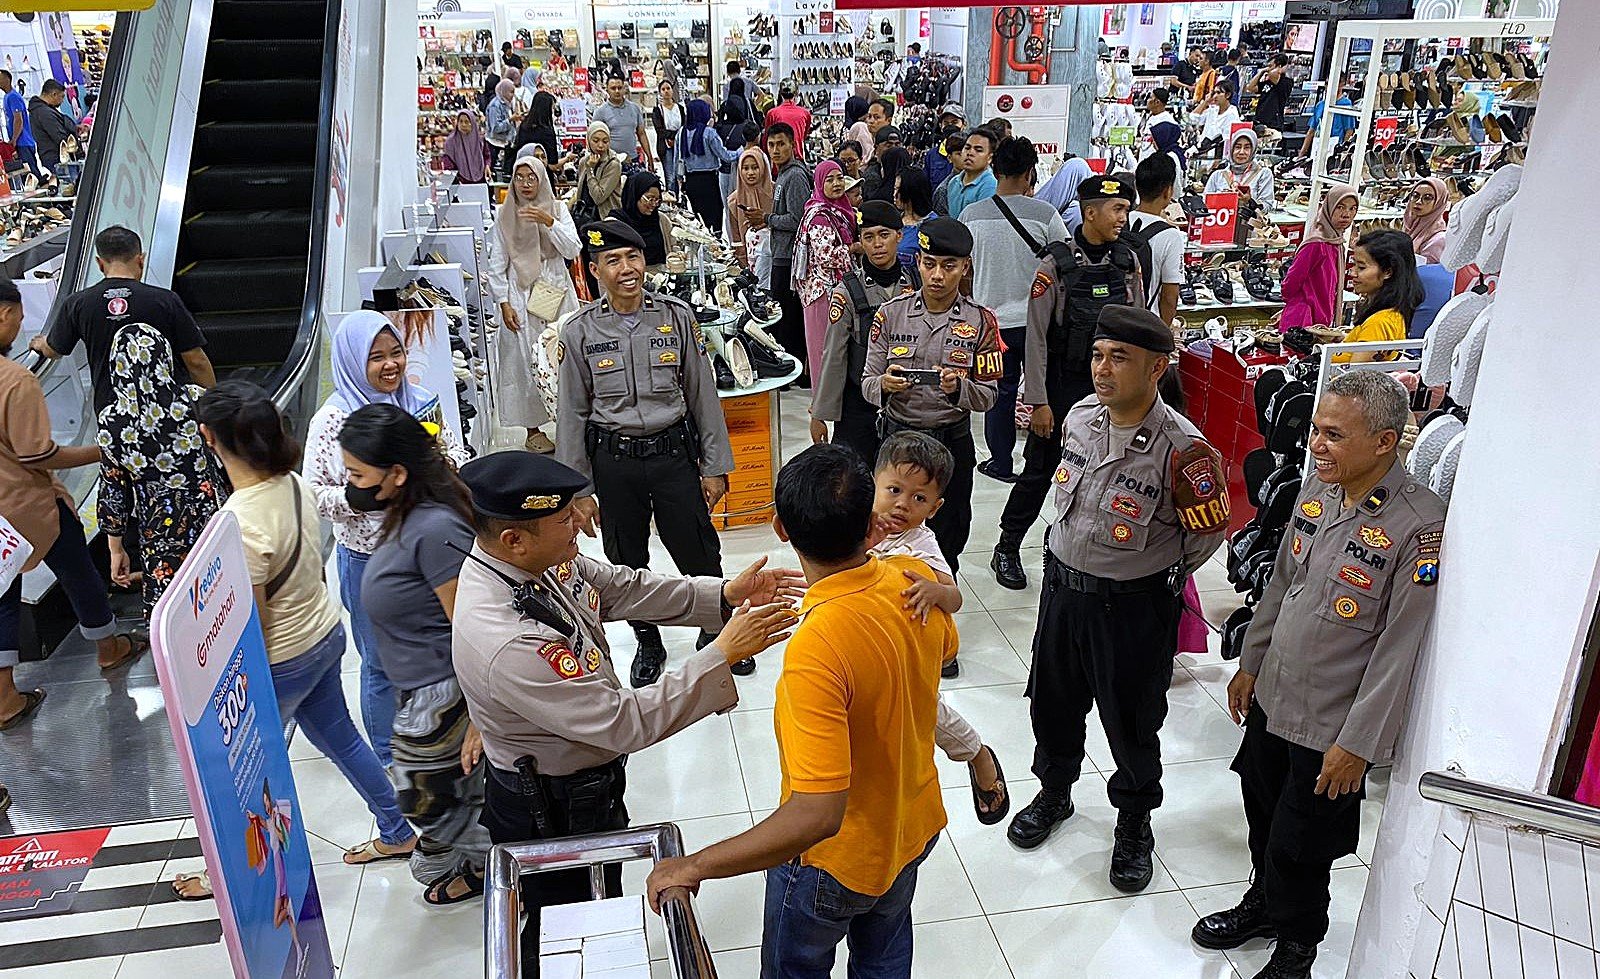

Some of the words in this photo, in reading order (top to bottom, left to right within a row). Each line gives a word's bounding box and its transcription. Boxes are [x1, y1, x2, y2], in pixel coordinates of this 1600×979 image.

[1500, 22, 1525, 35] FLD
[1115, 473, 1160, 500] POLRI
[1344, 540, 1387, 571] POLRI
[188, 556, 222, 622] Kredivo
[205, 585, 237, 653] matahari
[218, 672, 248, 747] 300
[16, 856, 89, 871] EKALATOR
